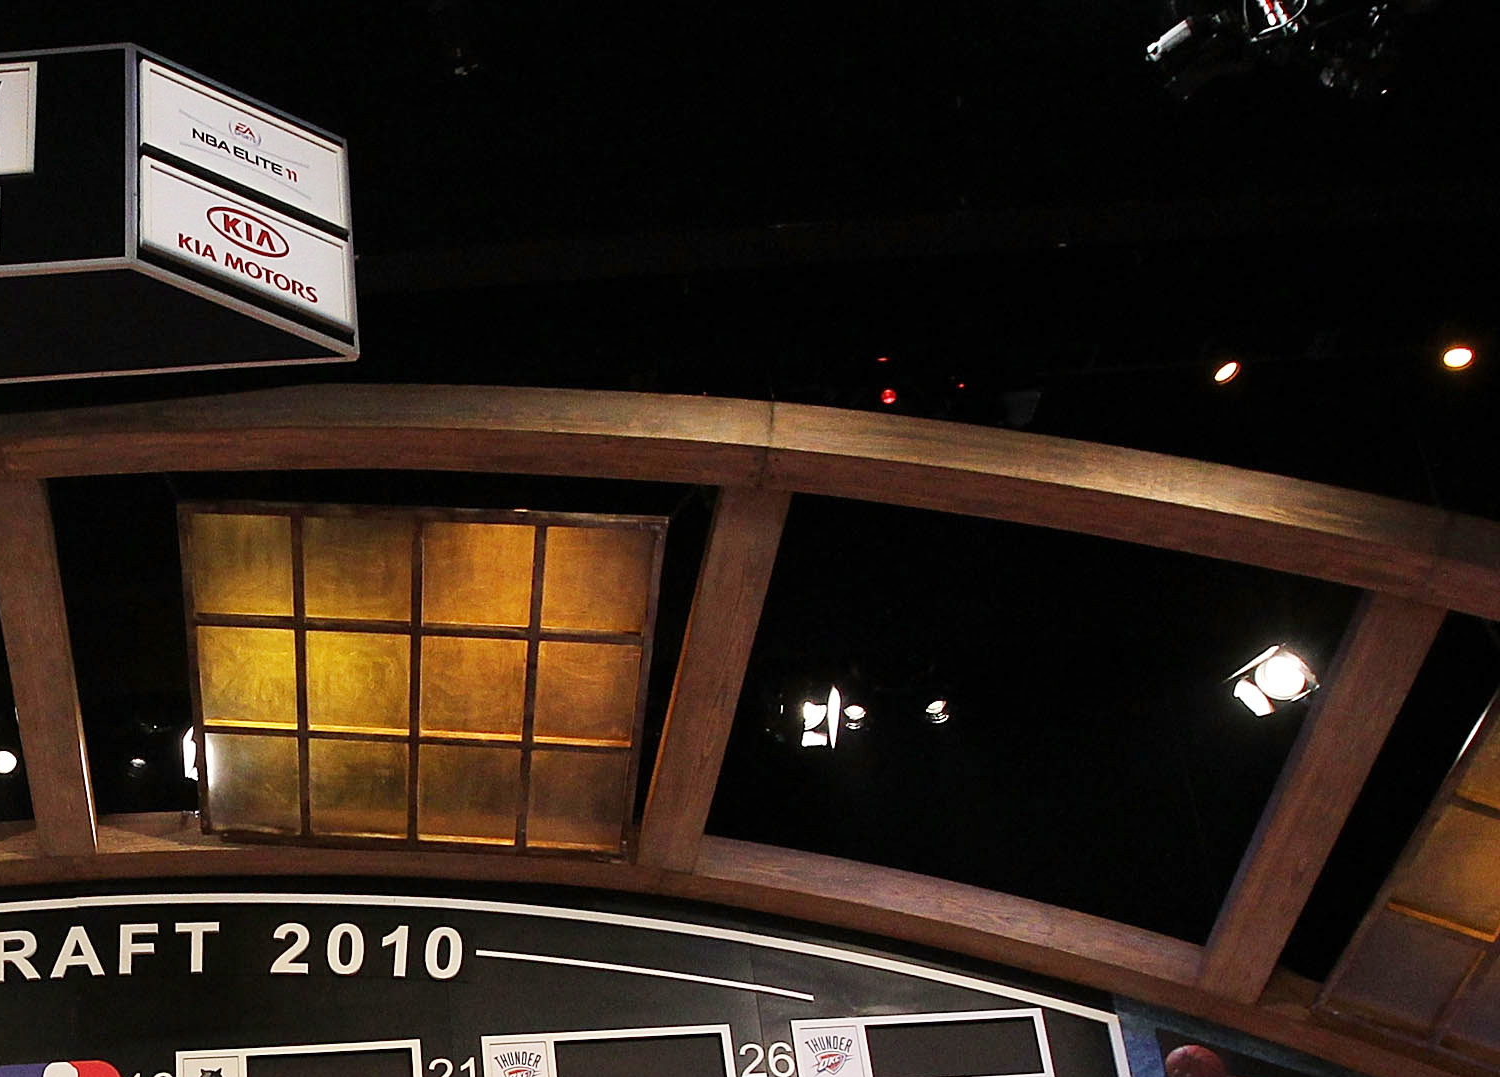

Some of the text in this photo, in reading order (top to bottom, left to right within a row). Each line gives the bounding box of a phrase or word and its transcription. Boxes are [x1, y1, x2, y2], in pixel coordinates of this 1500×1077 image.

[235, 122, 255, 139] EA
[192, 128, 298, 183] NBA ELITE 11
[223, 212, 276, 252] KIA
[178, 233, 319, 303] KIA MOTORS
[270, 923, 463, 980] 2010
[494, 1050, 542, 1070] THUNDER
[804, 1034, 853, 1054] THUNDER
